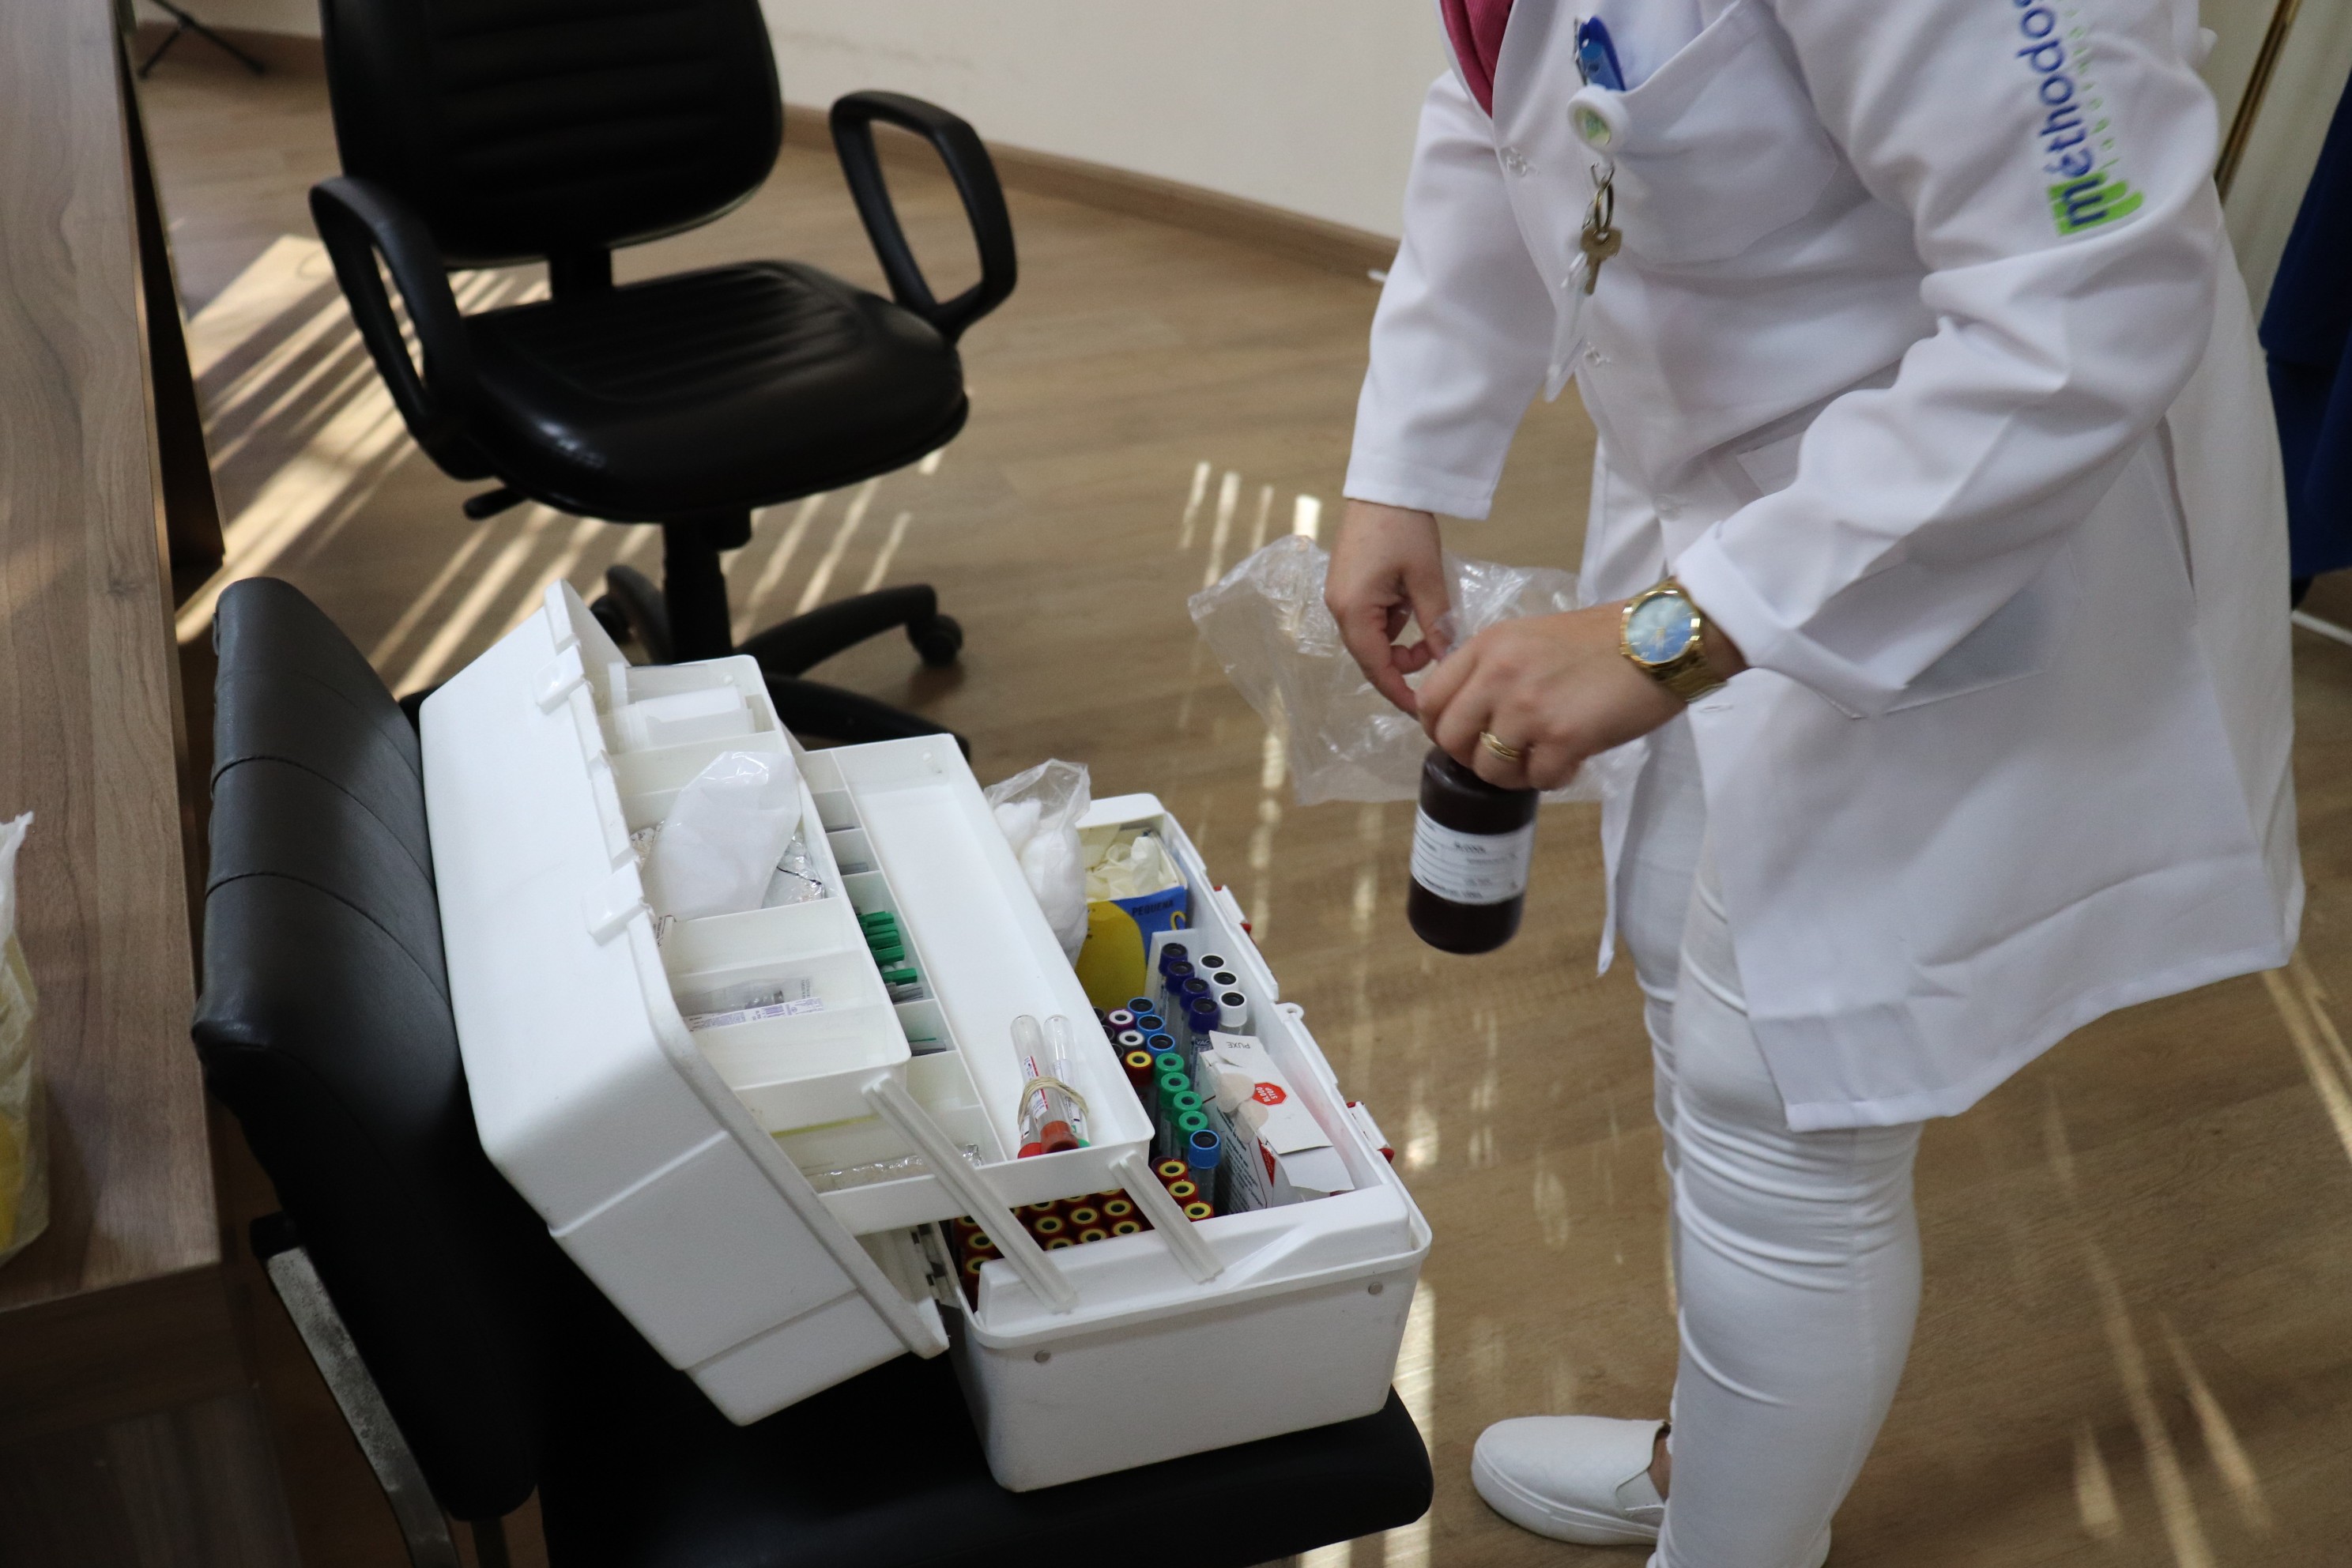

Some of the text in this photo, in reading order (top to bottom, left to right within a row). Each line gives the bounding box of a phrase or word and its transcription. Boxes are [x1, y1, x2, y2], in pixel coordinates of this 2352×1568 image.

[1132, 899, 1174, 917] PEQUENA
[1256, 1087, 1271, 1102] BLOOD
[1265, 1087, 1278, 1099] STOP
